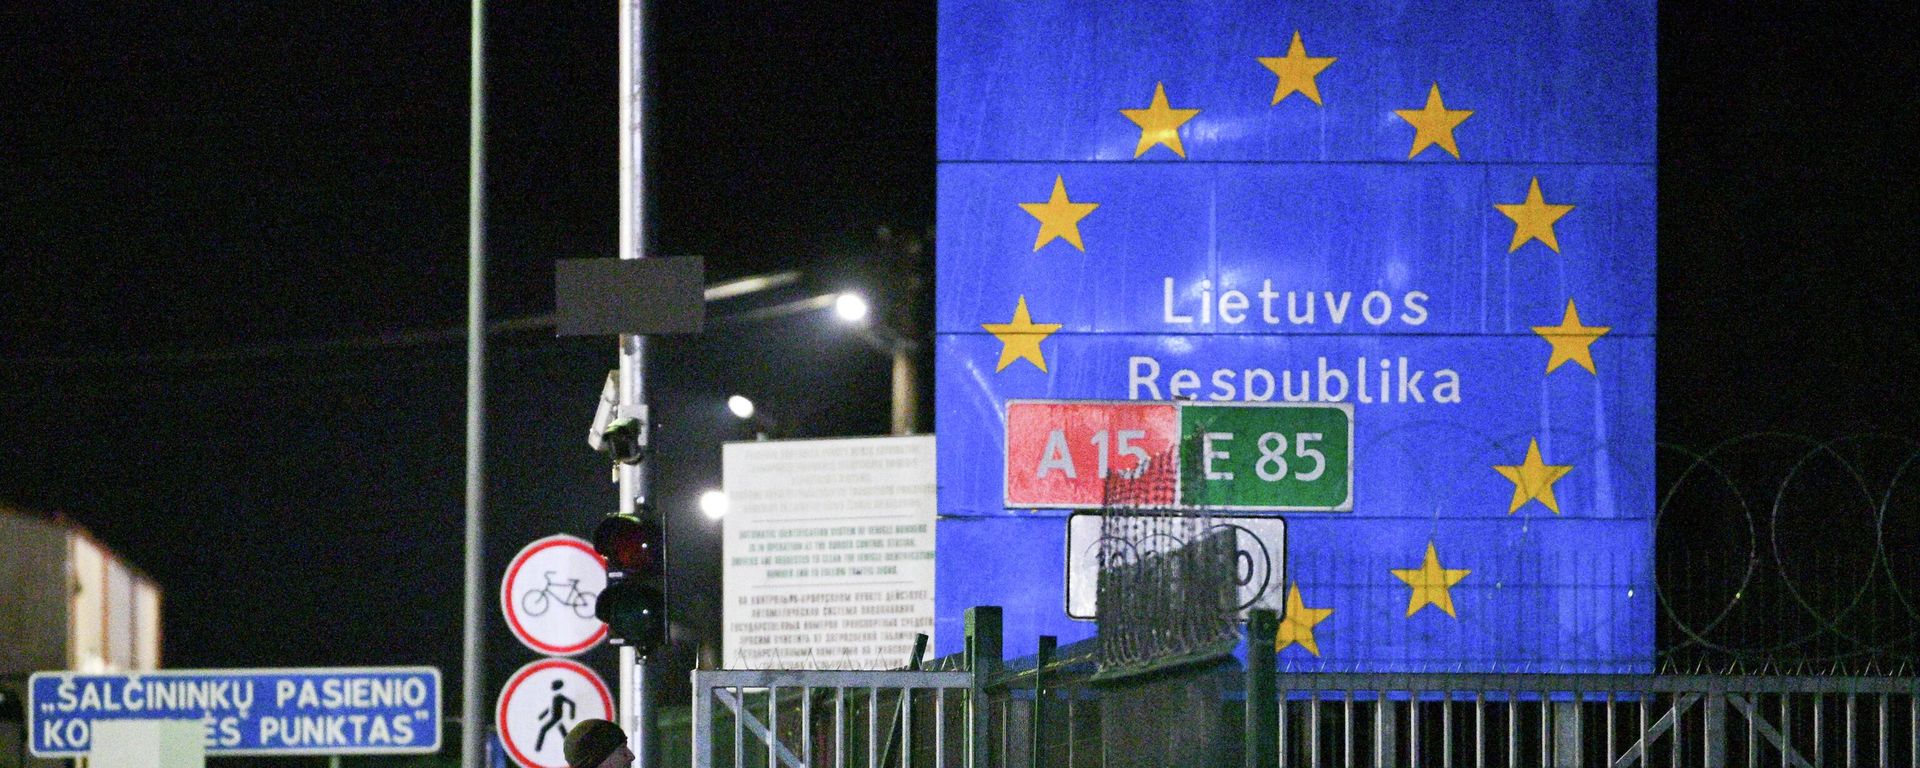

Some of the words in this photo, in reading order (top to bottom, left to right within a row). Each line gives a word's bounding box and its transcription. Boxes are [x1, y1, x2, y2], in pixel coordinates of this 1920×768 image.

[1164, 277, 1429, 325] Lietuvos
[1128, 356, 1462, 403] Respublika
[1037, 430, 1077, 479] A
[1091, 430, 1151, 480] 15
[1203, 432, 1234, 481] E
[1255, 432, 1326, 482] 85
[276, 678, 427, 709] PASIENIO
